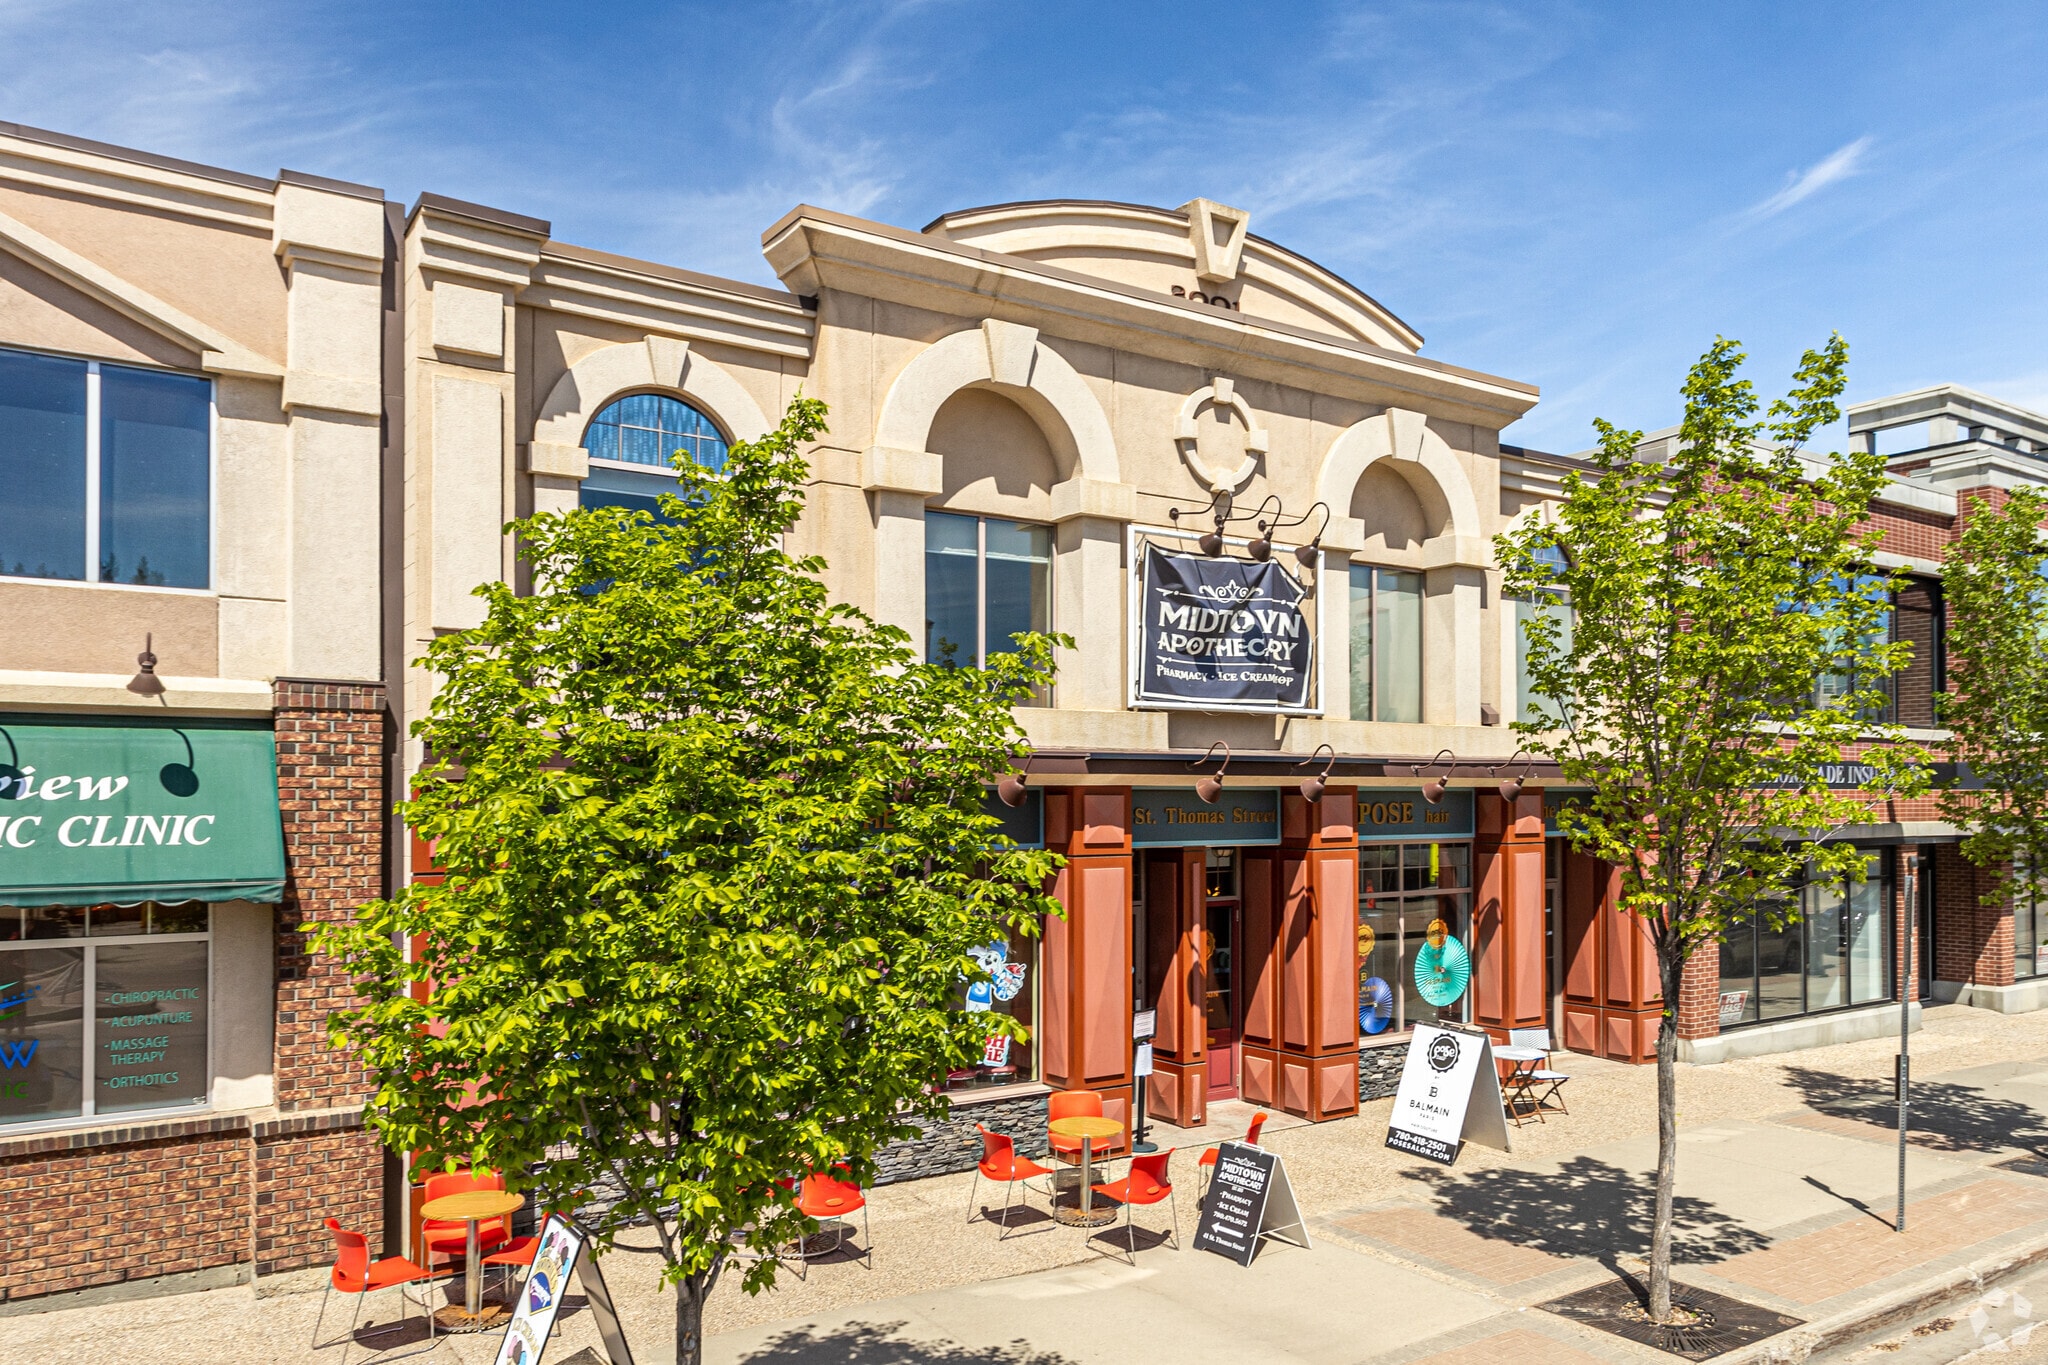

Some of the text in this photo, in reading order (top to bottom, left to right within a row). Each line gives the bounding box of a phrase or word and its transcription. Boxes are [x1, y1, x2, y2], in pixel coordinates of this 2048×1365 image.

[1134, 807, 1276, 825] St. Thomas Street
[1358, 801, 1450, 825] POSE hair
[58, 814, 215, 847] CLINIC
[111, 987, 199, 1005] CHIROPRACTIC
[1720, 1002, 1743, 1014] LEASE
[111, 1011, 193, 1028] ACUPUNTURE
[110, 1036, 169, 1051] MASSAGE
[110, 1050, 166, 1066] THERAPY
[109, 1071, 180, 1089] ORTHOTICS
[1409, 1099, 1450, 1117] BALMAIN
[1388, 1137, 1450, 1161] POSESALON.COM
[1395, 1130, 1447, 1152] 780-418-2501
[1219, 1171, 1263, 1189] APOTHECARY
[1221, 1162, 1265, 1182] MIDTOWN
